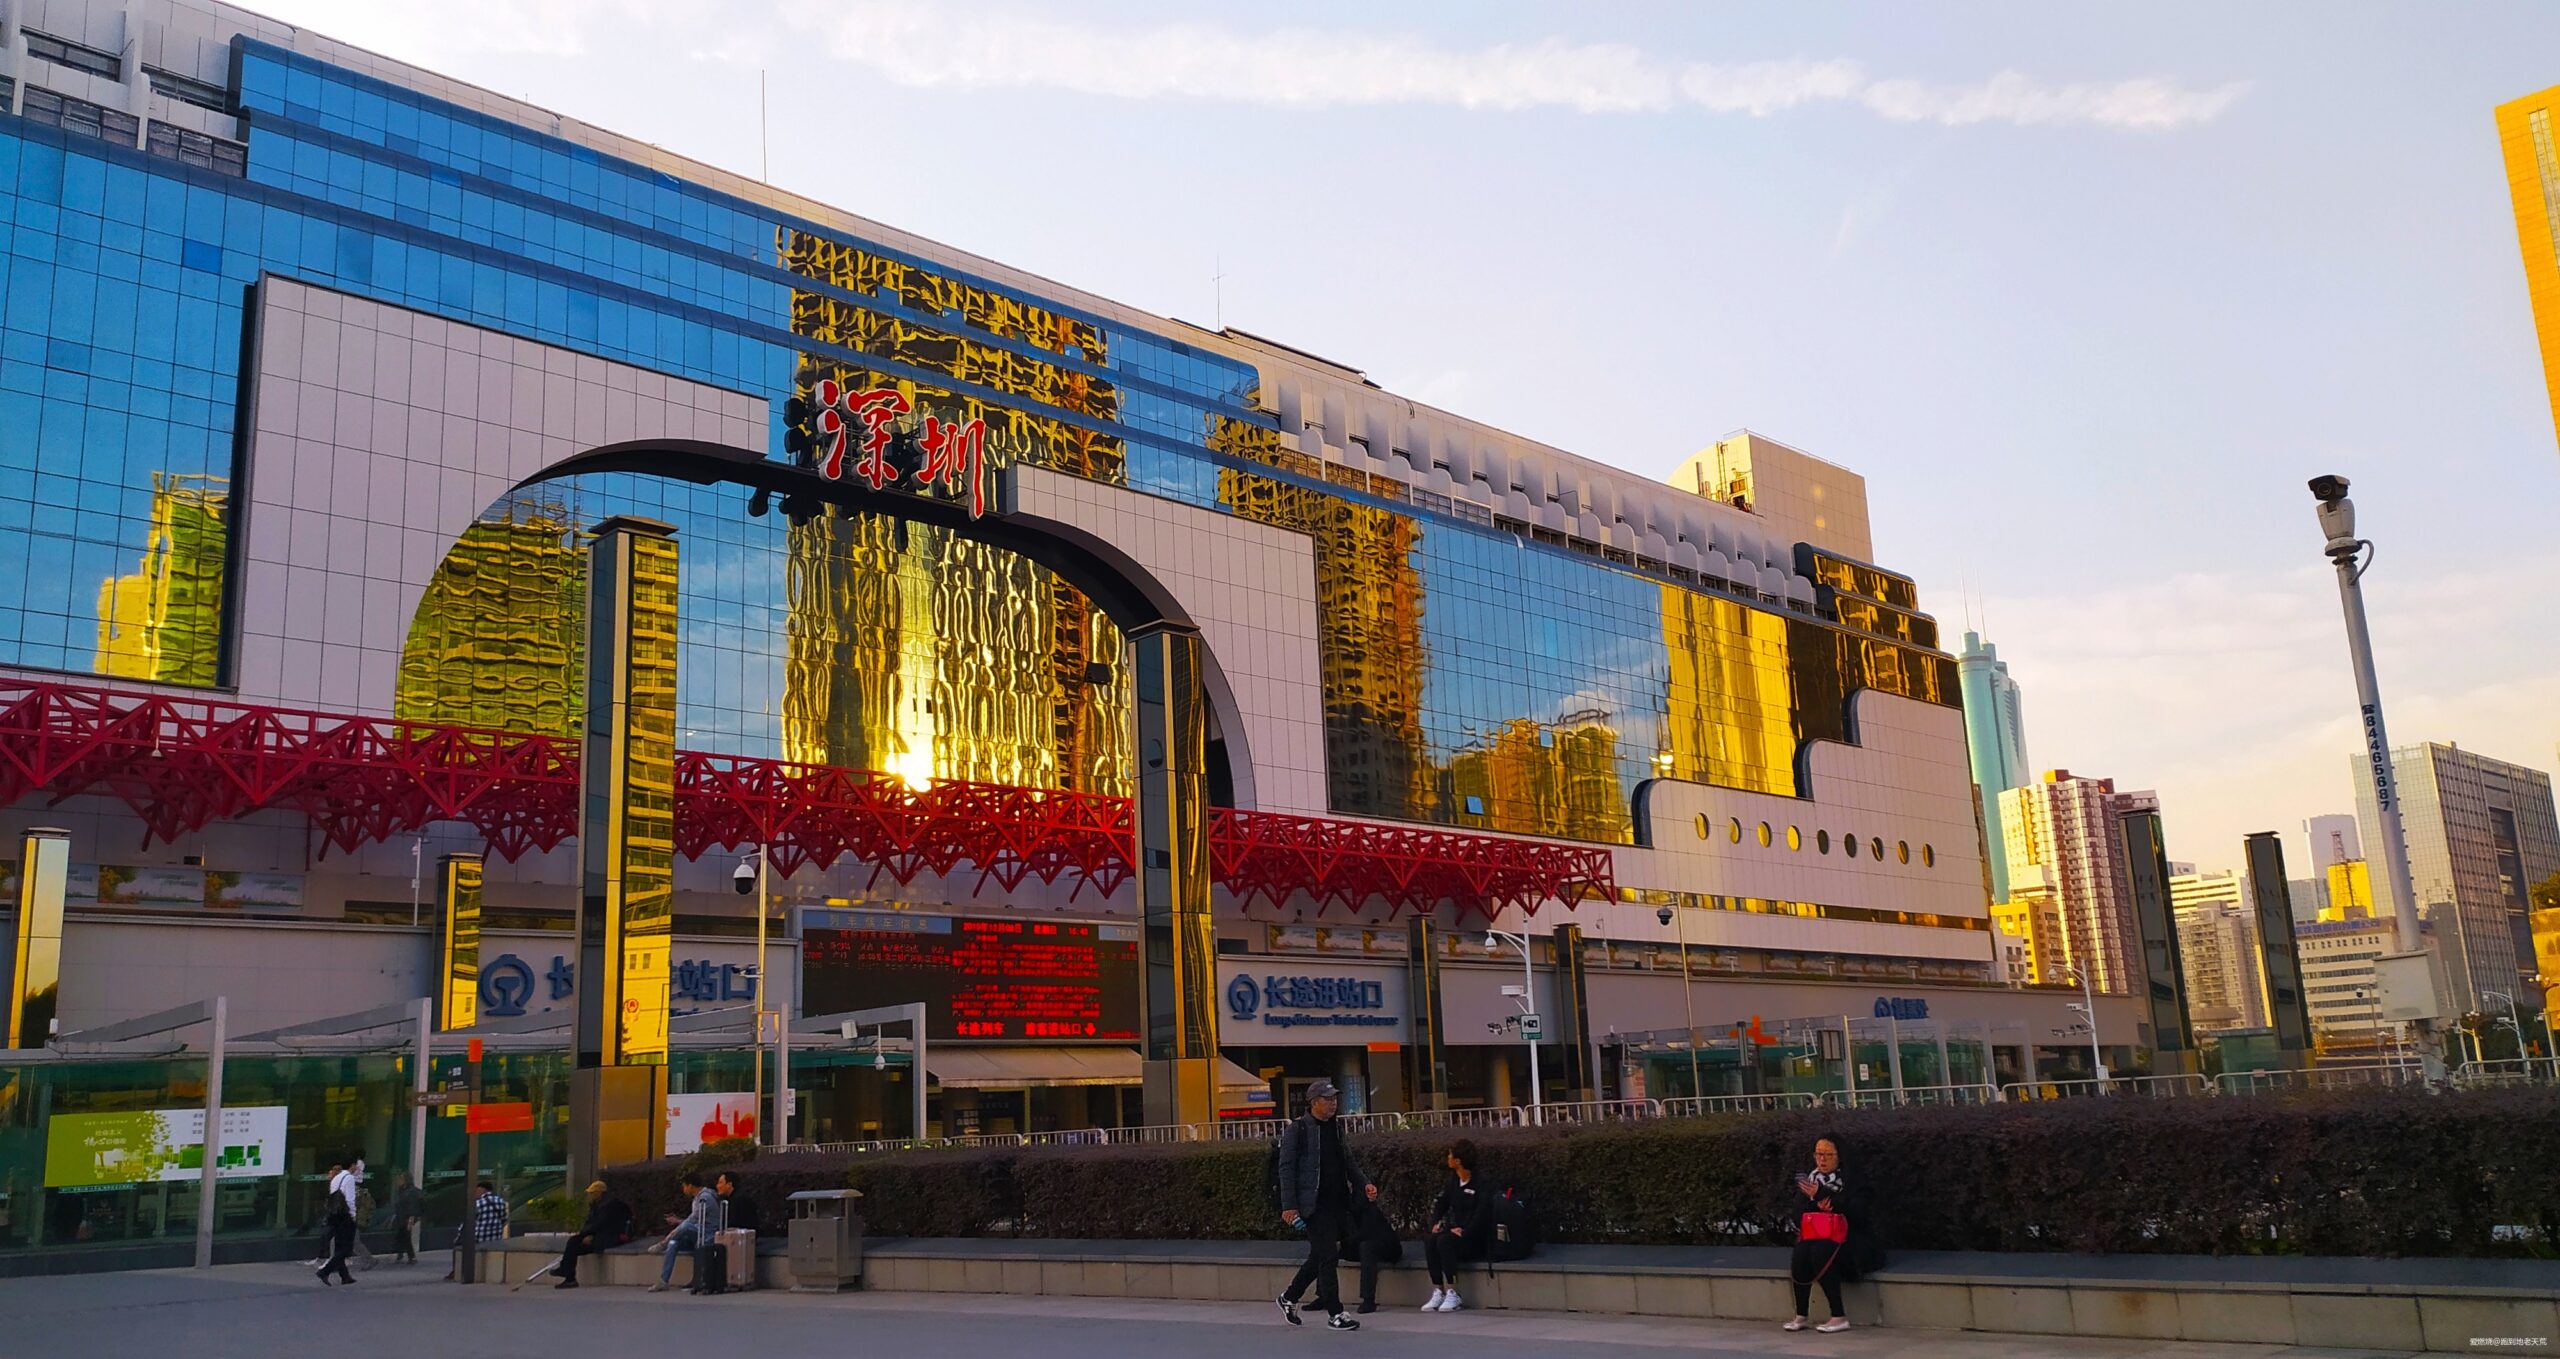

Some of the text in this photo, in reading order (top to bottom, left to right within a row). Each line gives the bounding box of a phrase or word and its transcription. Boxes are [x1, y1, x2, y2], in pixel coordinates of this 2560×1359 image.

[816, 379, 986, 521] 深圳
[1265, 975, 1383, 1009] 长途进站口
[956, 1021, 1004, 1036] 长途列车
